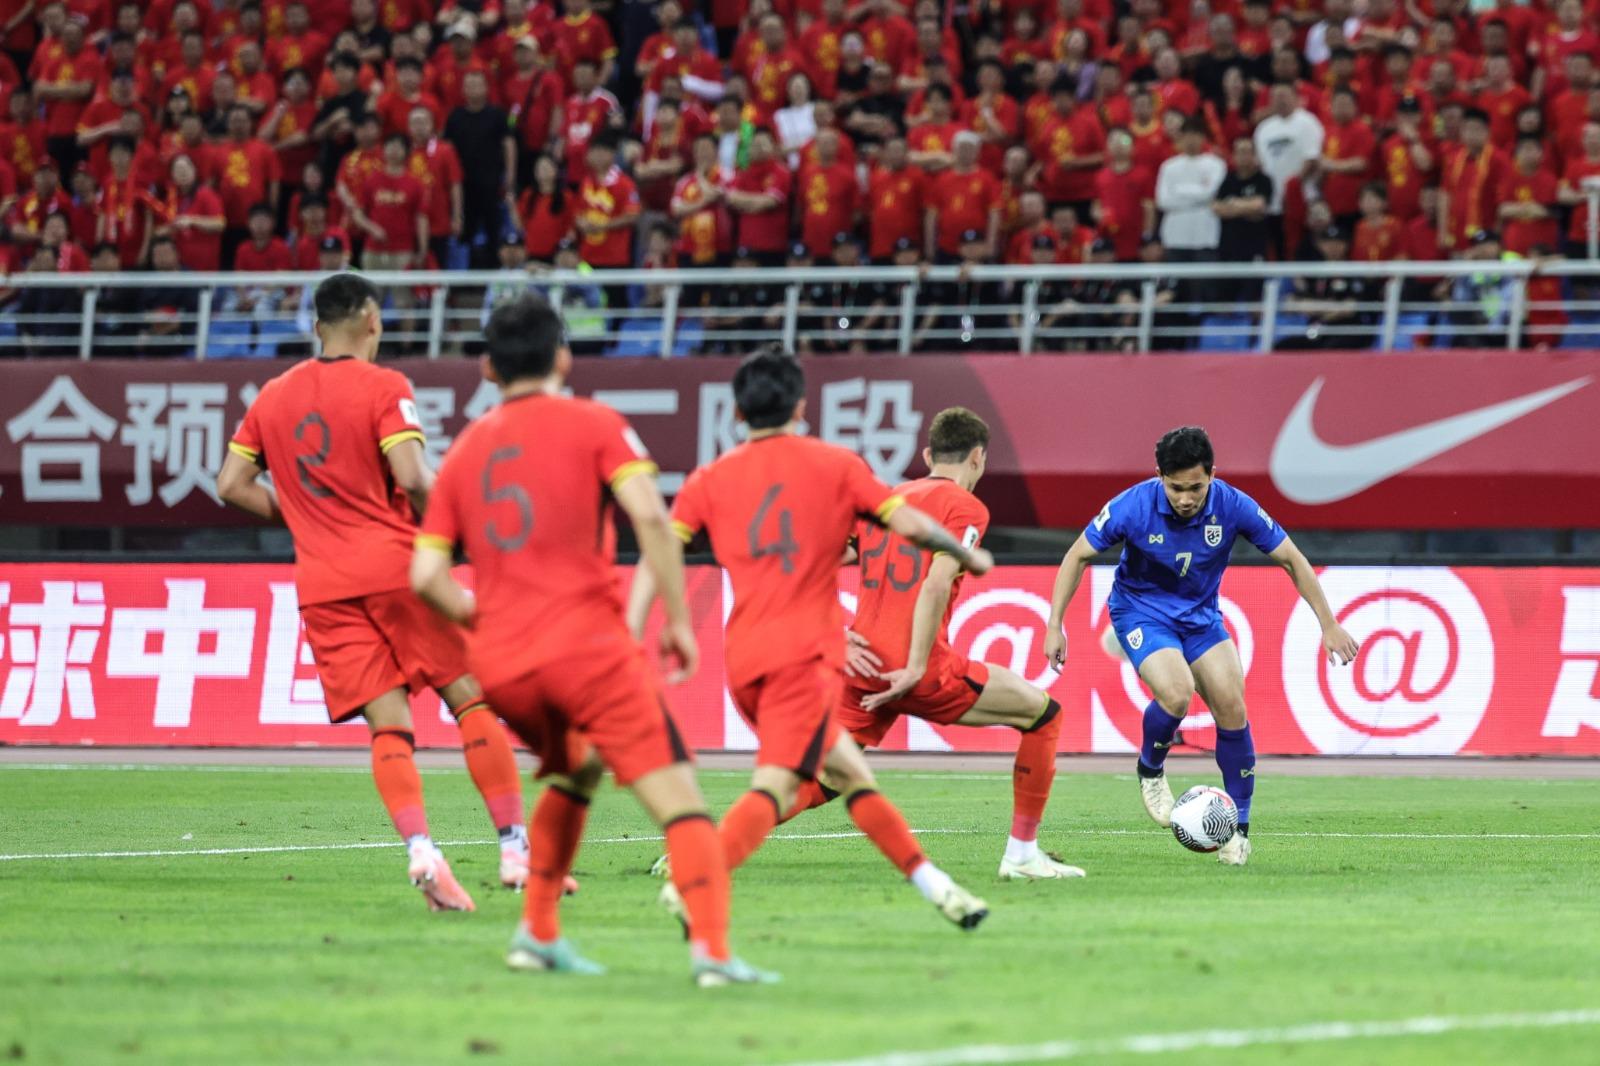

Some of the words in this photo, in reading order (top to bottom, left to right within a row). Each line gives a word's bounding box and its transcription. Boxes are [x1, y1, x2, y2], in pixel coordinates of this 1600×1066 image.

[294, 411, 336, 498] 2
[480, 445, 534, 554] 5
[747, 483, 799, 574] 4
[1176, 552, 1193, 577] 7
